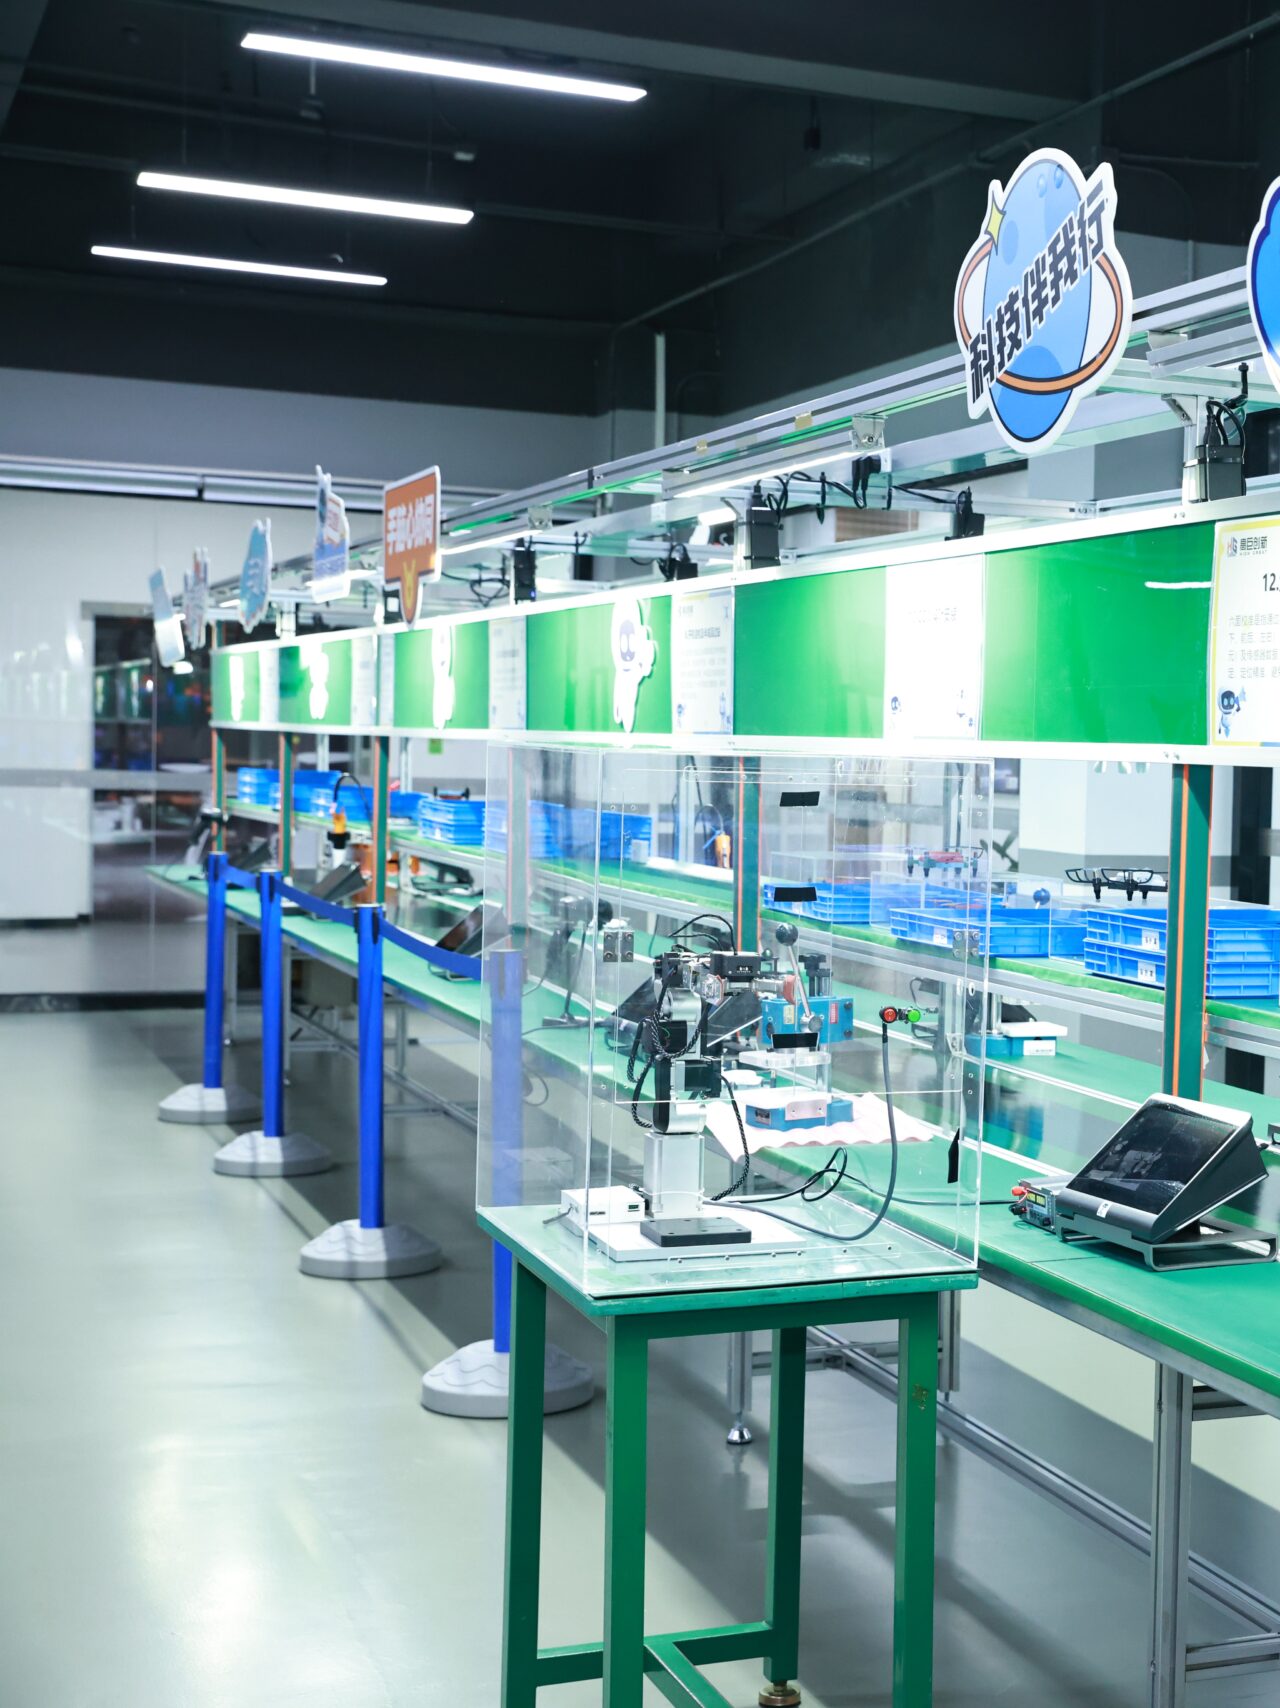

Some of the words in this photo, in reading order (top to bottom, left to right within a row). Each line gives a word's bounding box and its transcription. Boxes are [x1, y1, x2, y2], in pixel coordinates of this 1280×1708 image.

[968, 179, 1108, 403] 科技伴我行
